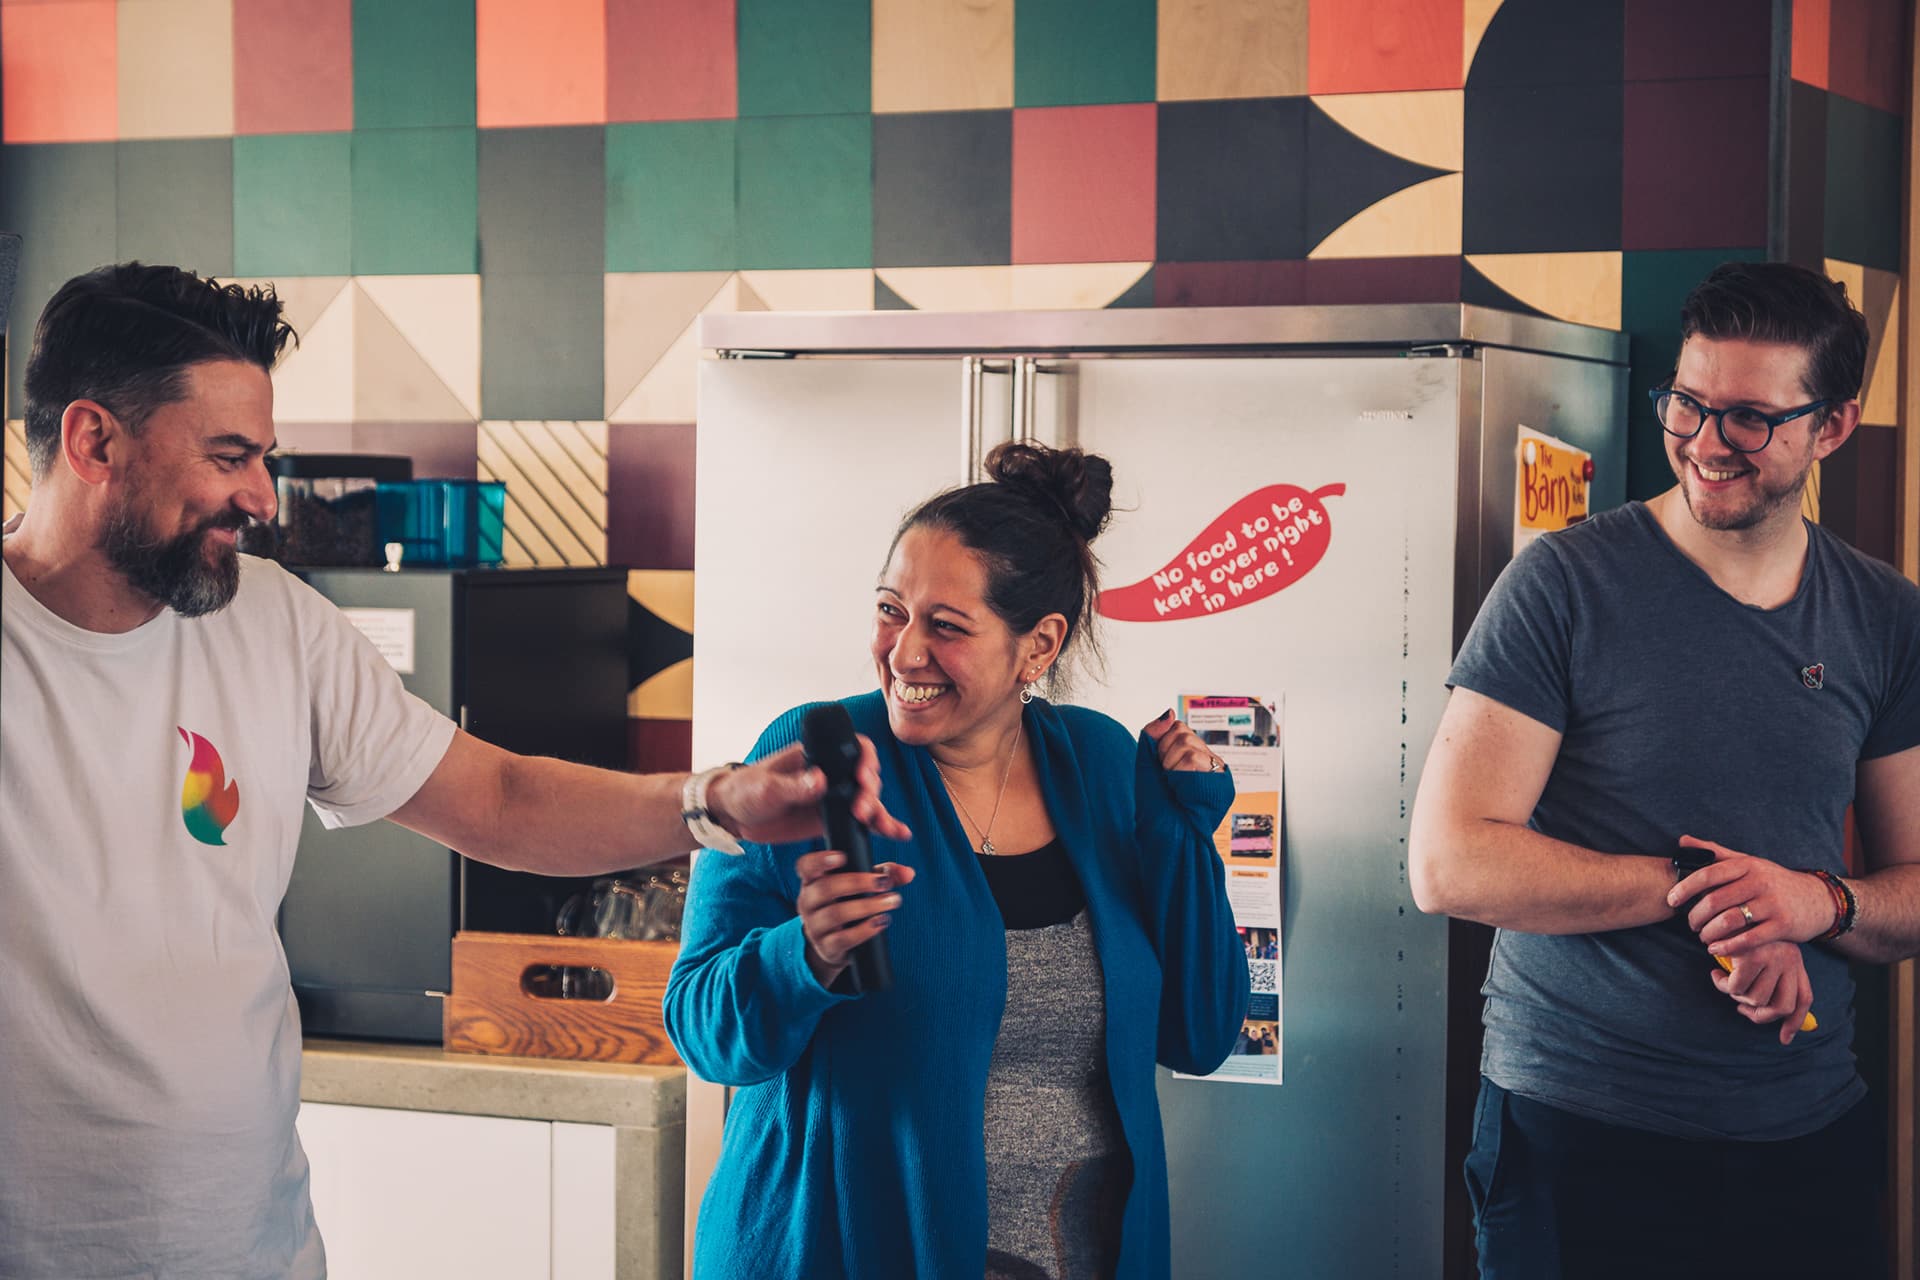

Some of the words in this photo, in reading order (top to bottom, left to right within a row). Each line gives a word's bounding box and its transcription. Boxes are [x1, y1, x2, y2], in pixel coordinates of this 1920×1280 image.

[1540, 444, 1553, 469] The
[1525, 461, 1570, 521] Barn
[1153, 567, 1183, 592] No
[1187, 531, 1237, 571] food
[1241, 517, 1270, 539] to
[1272, 497, 1303, 521] be
[1154, 577, 1206, 616] kept
[1210, 546, 1258, 583] over
[1263, 508, 1323, 552] night
[1201, 592, 1226, 612] in
[1228, 562, 1279, 597] here
[1282, 548, 1294, 567] !
